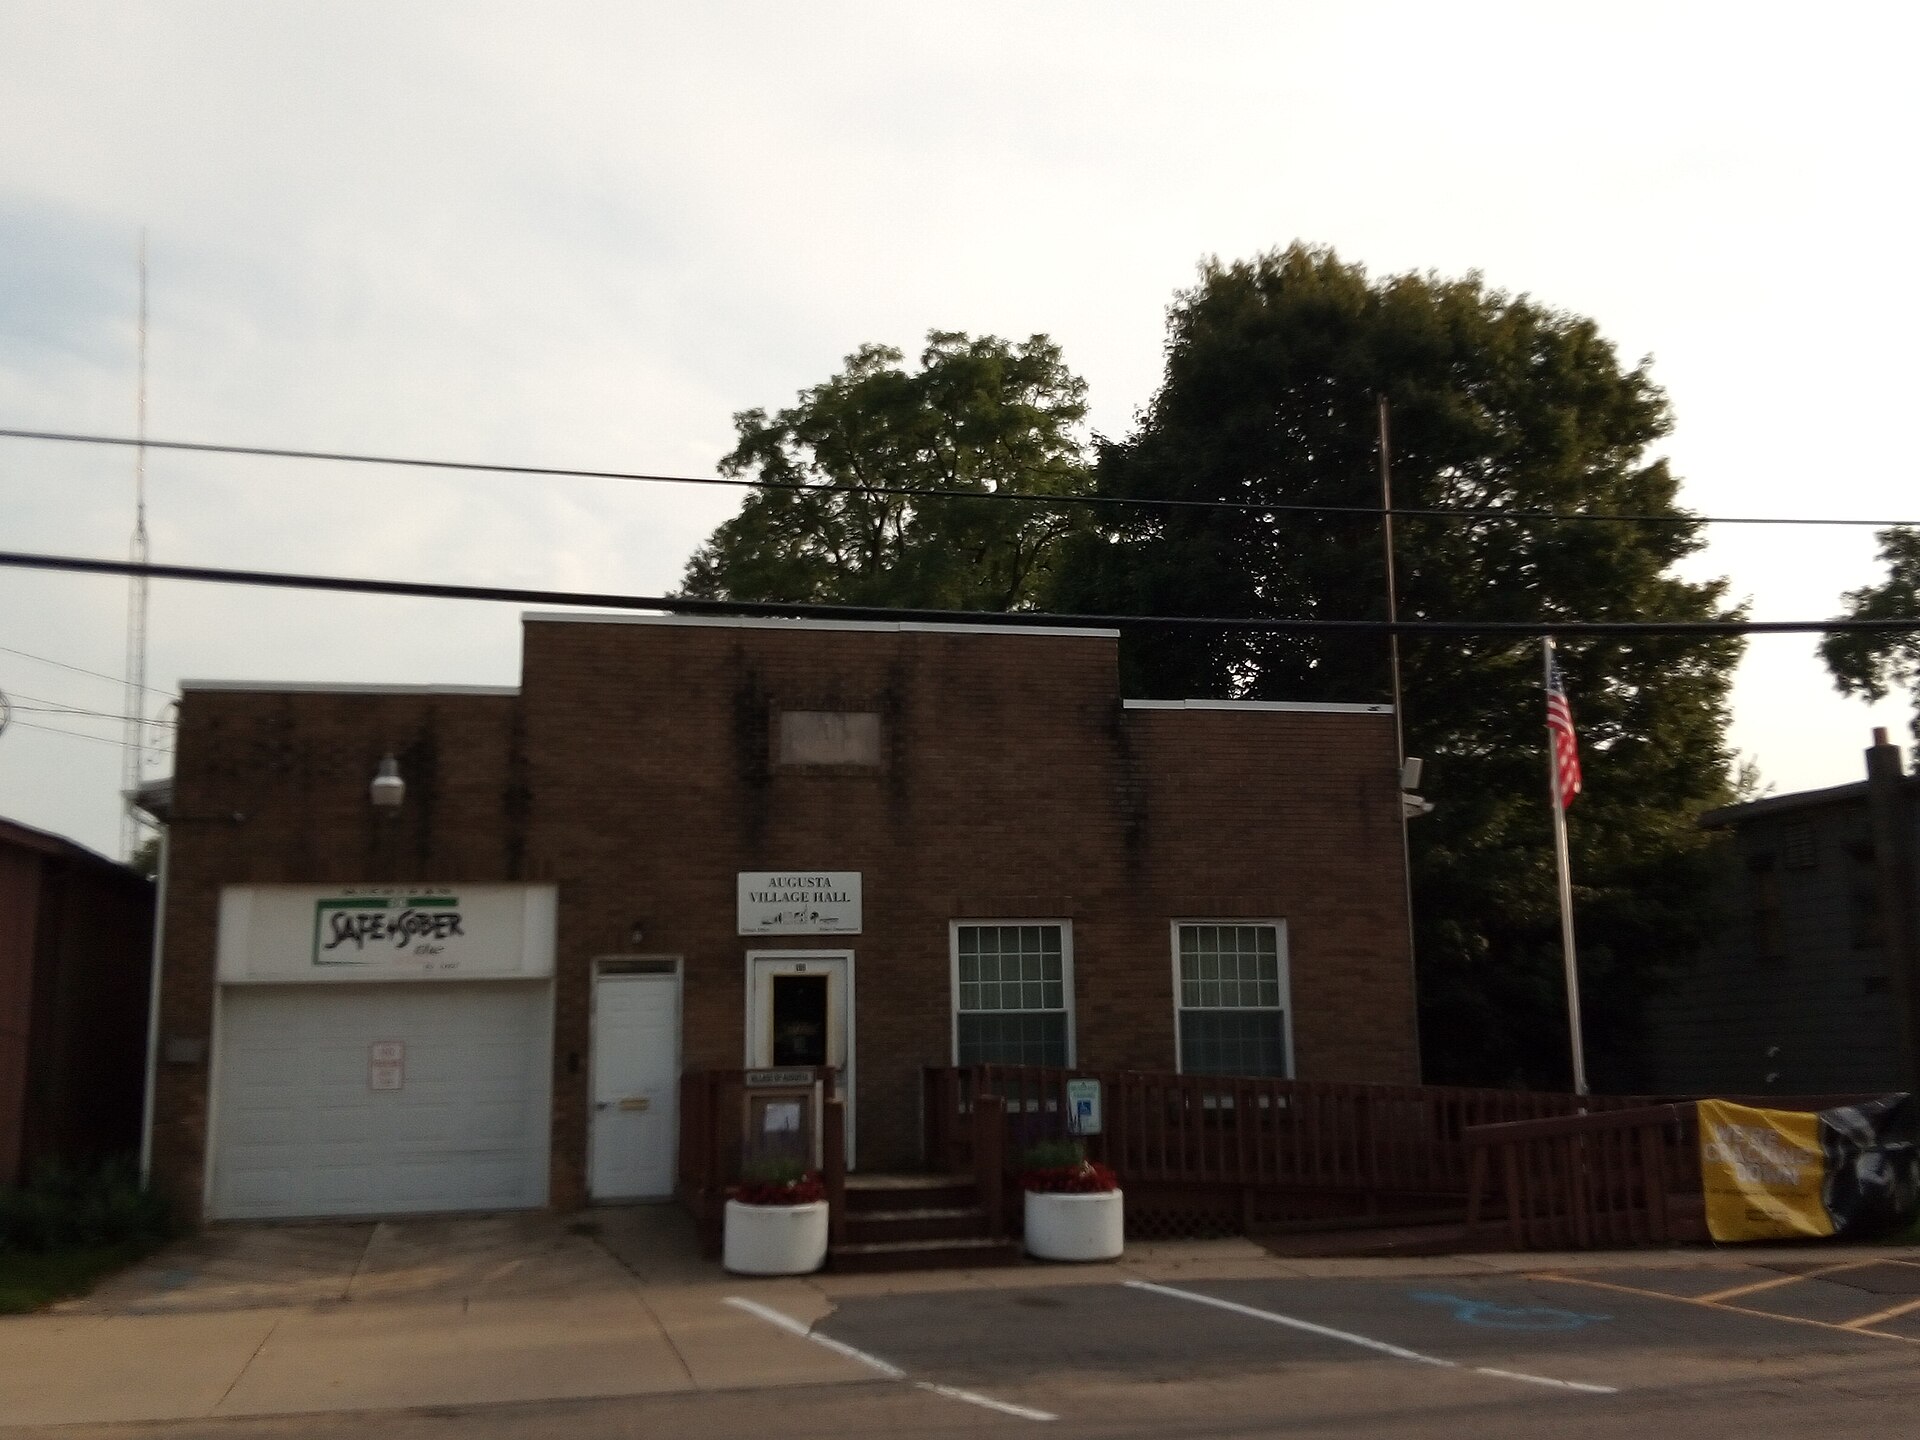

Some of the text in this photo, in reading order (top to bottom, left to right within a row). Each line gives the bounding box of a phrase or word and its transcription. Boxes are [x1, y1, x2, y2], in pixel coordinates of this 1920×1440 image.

[768, 877, 833, 888] AUGUSTA
[748, 891, 851, 903] VILLAGE HALL
[323, 910, 386, 949] SAFE
[395, 909, 465, 948] SOBER
